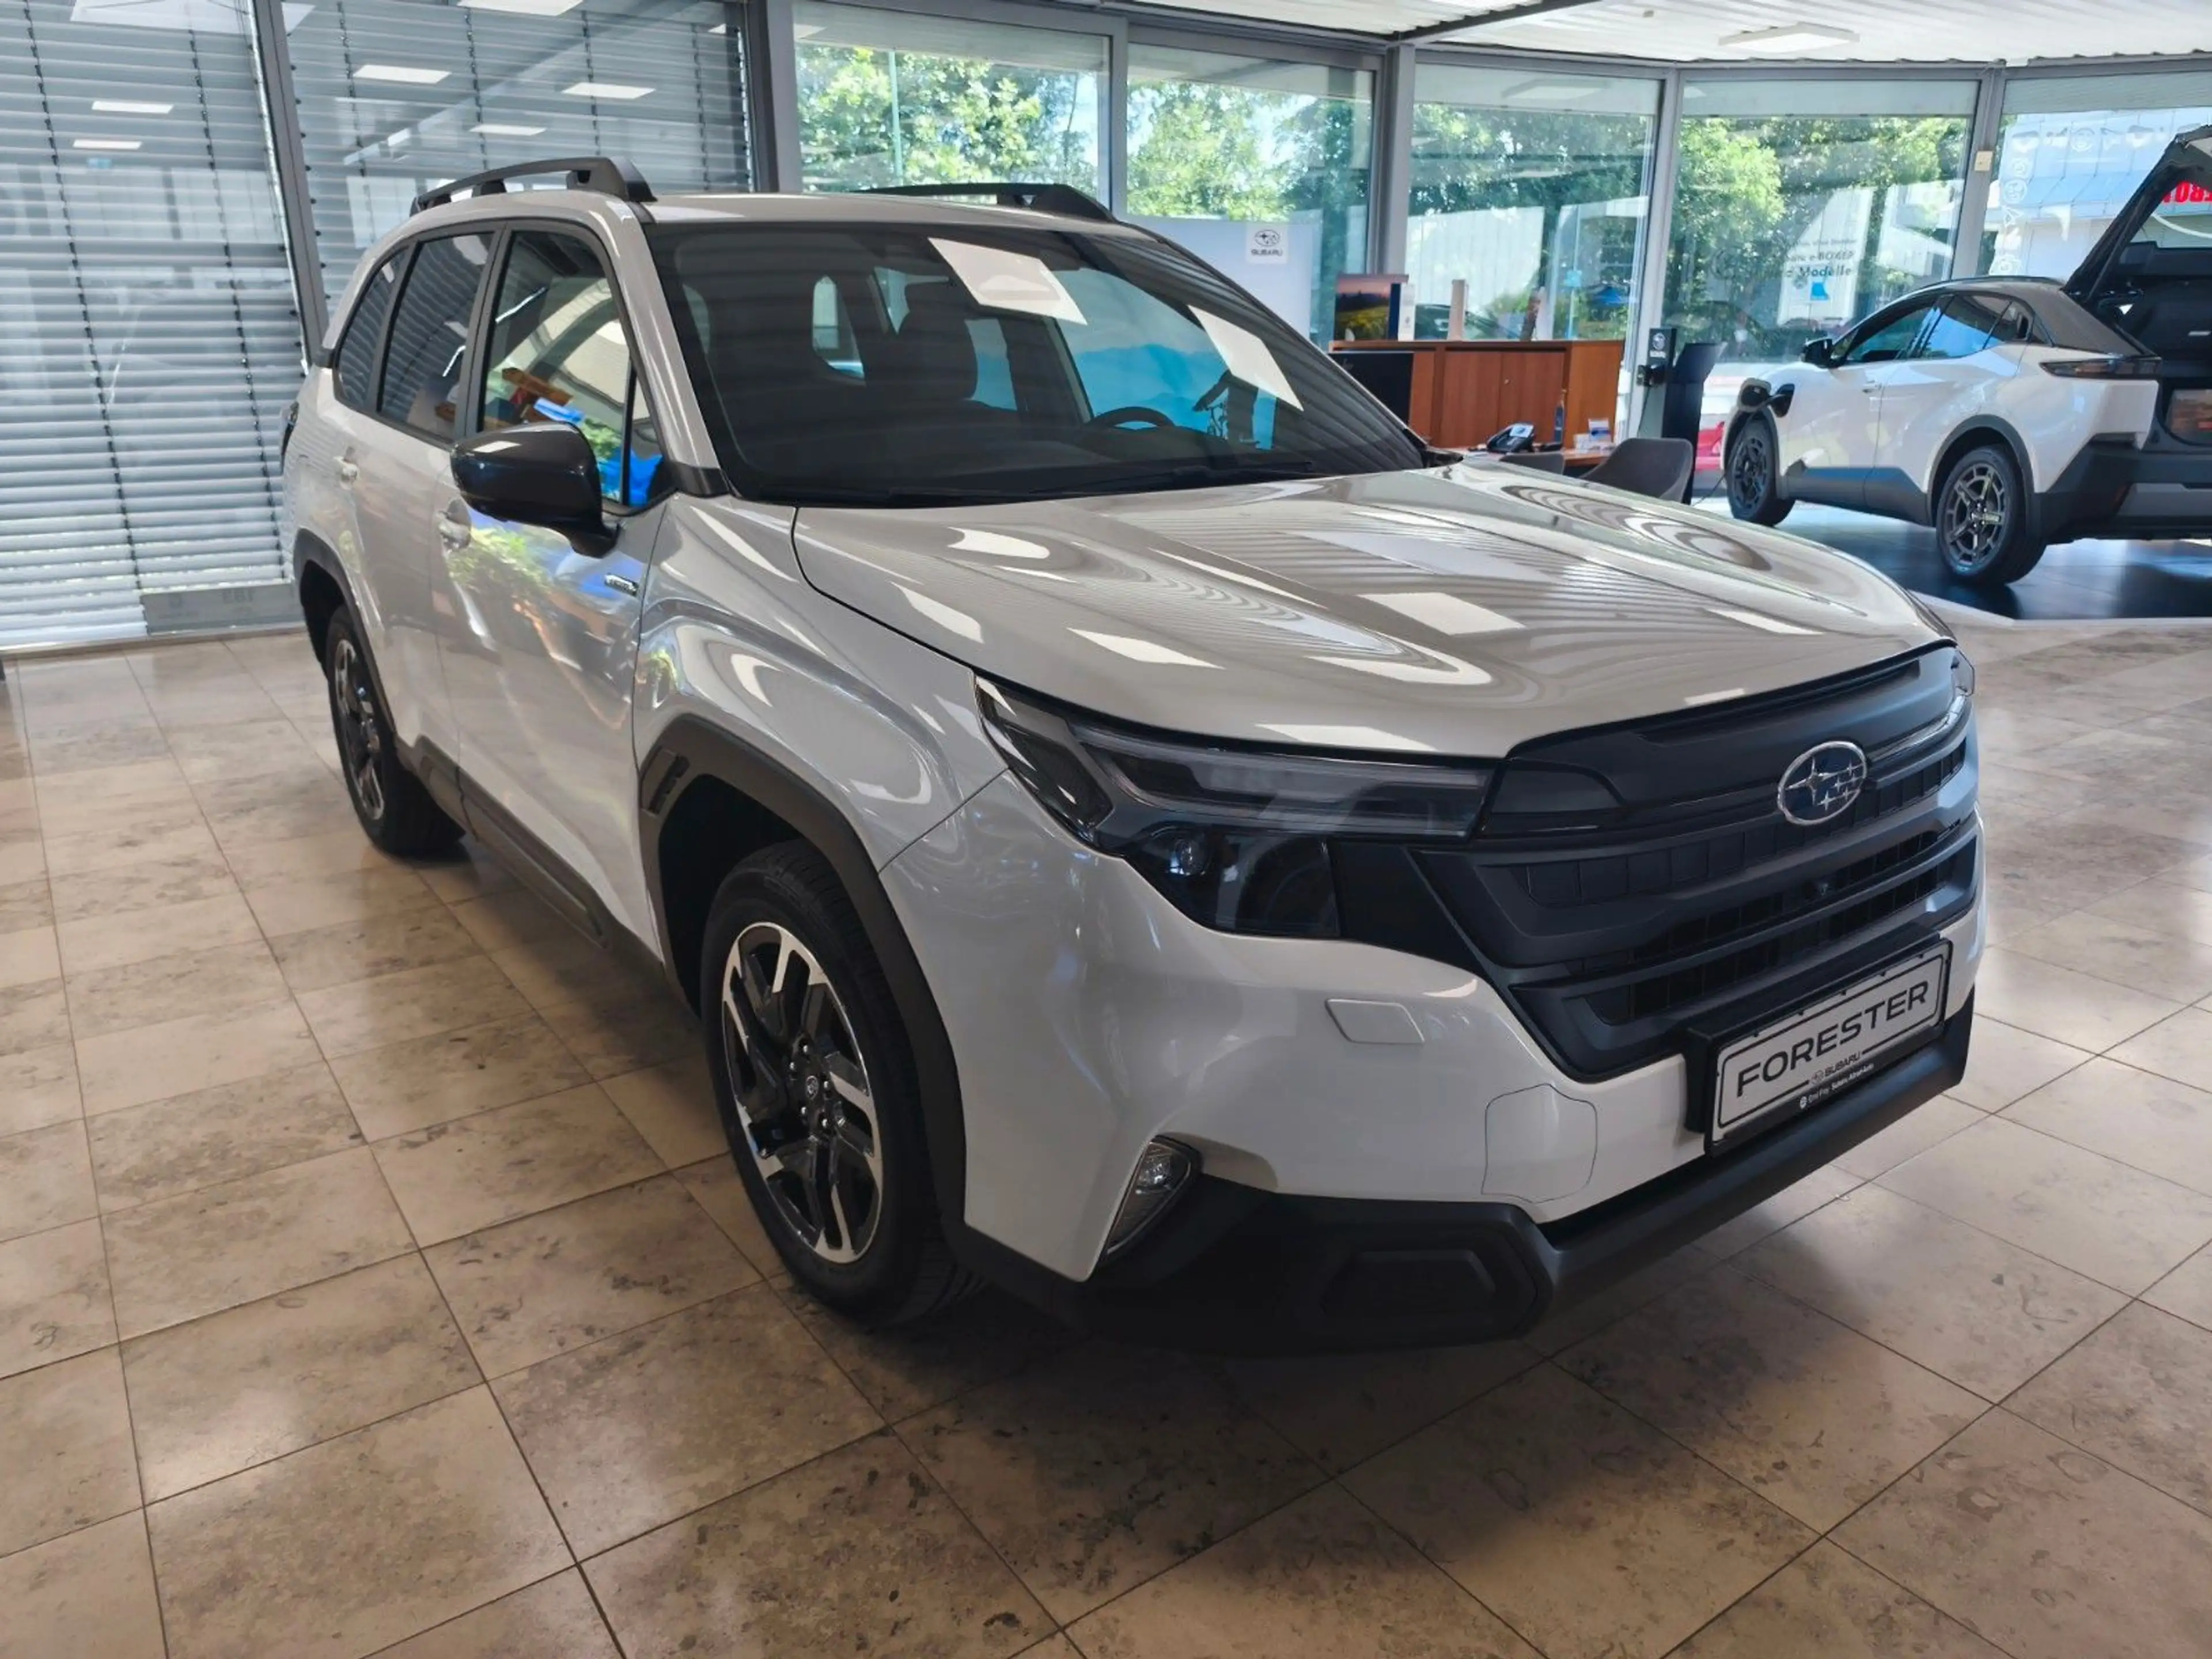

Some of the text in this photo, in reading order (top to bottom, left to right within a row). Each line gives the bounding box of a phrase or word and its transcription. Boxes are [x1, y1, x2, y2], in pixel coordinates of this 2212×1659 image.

[1251, 248, 1283, 256] SUBARU
[1799, 265, 1851, 276] Modelle
[1737, 980, 1929, 1097] FORESTER
[1824, 1051, 1861, 1076] SUBARU
